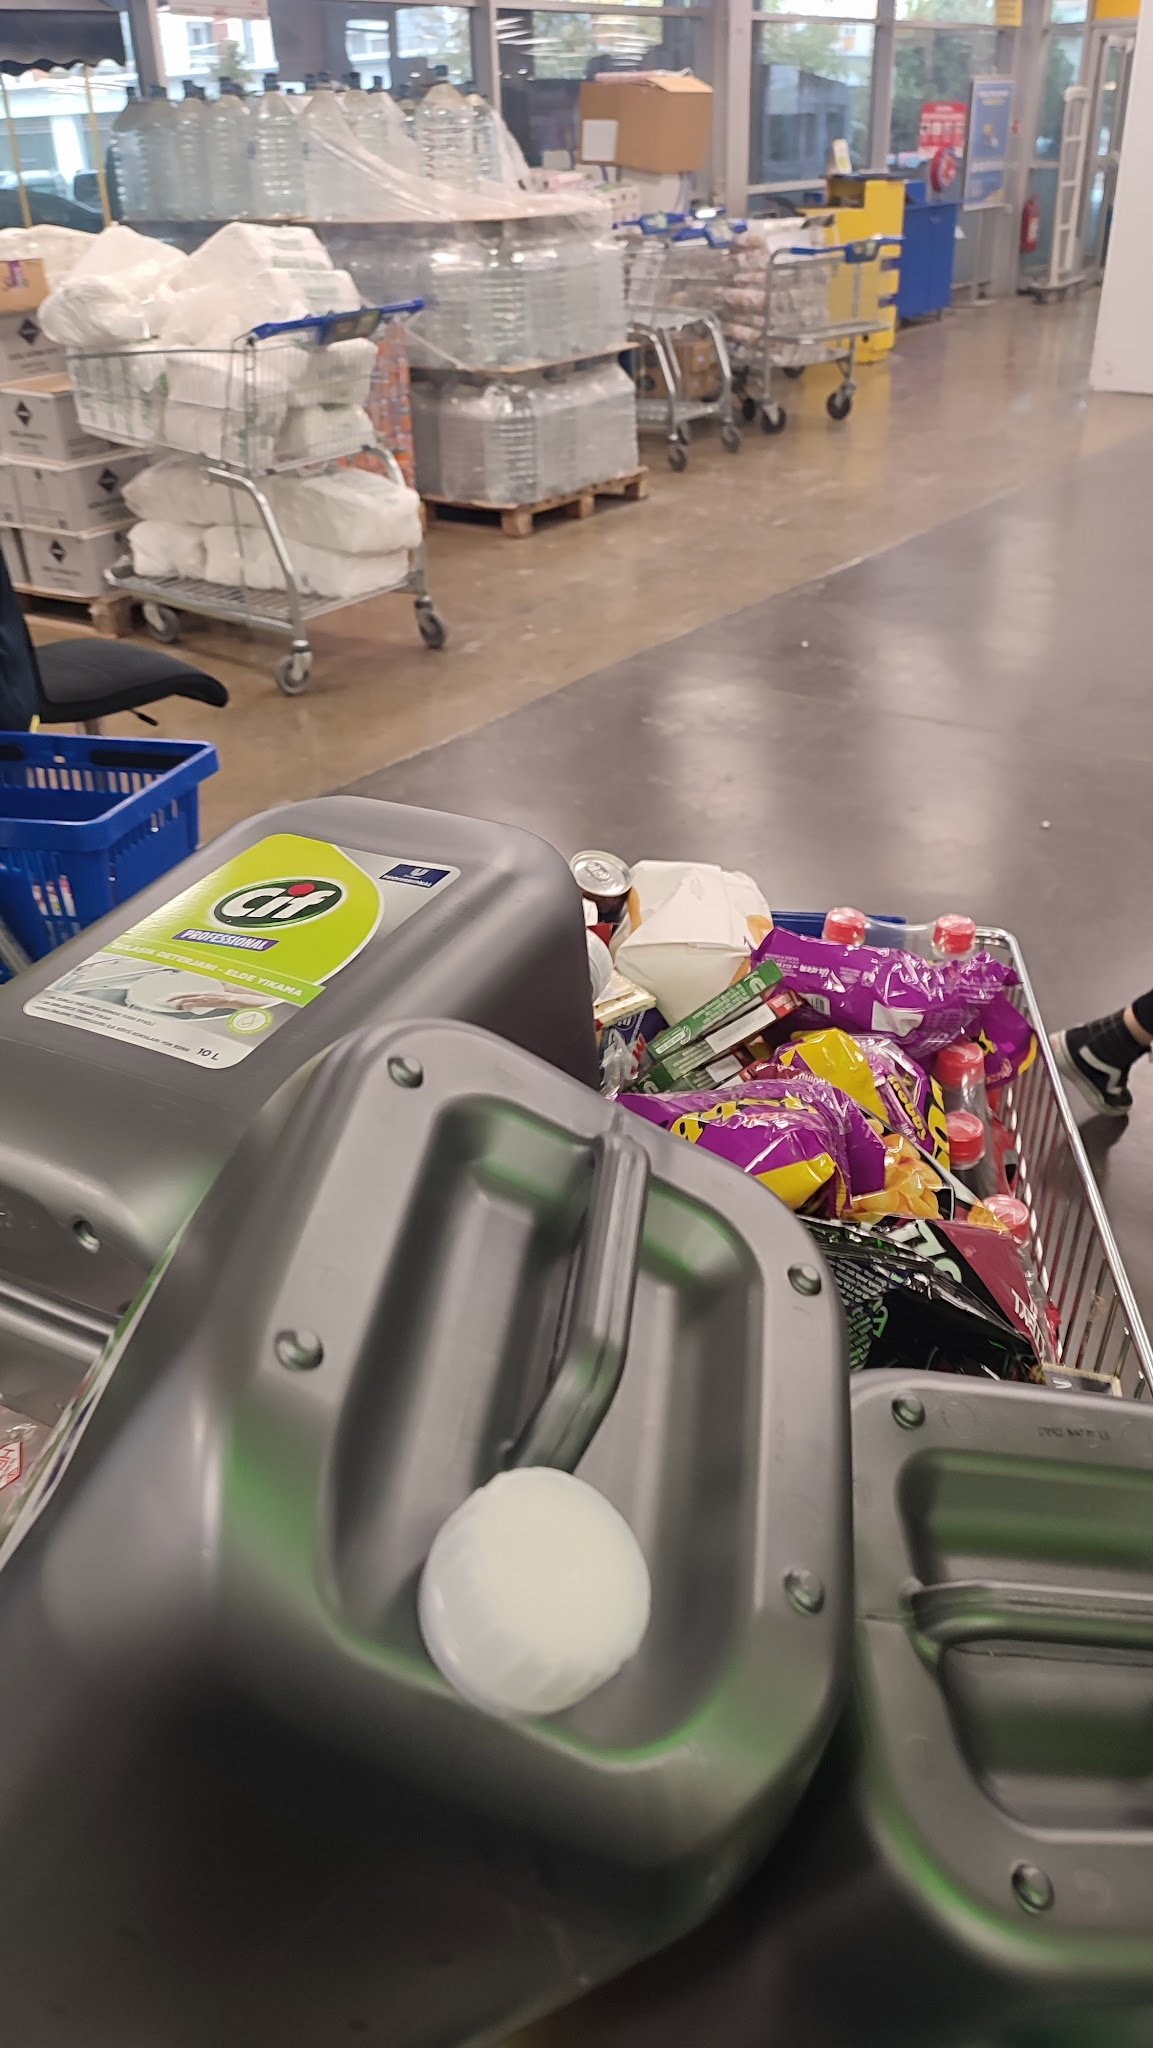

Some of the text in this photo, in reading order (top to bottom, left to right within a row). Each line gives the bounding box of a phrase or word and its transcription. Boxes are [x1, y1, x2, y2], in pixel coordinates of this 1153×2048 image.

[221, 883, 337, 919] Cif
[179, 929, 270, 951] PROFESSIONAL
[256, 977, 303, 997] YIKAMA
[195, 1047, 212, 1057] 10
